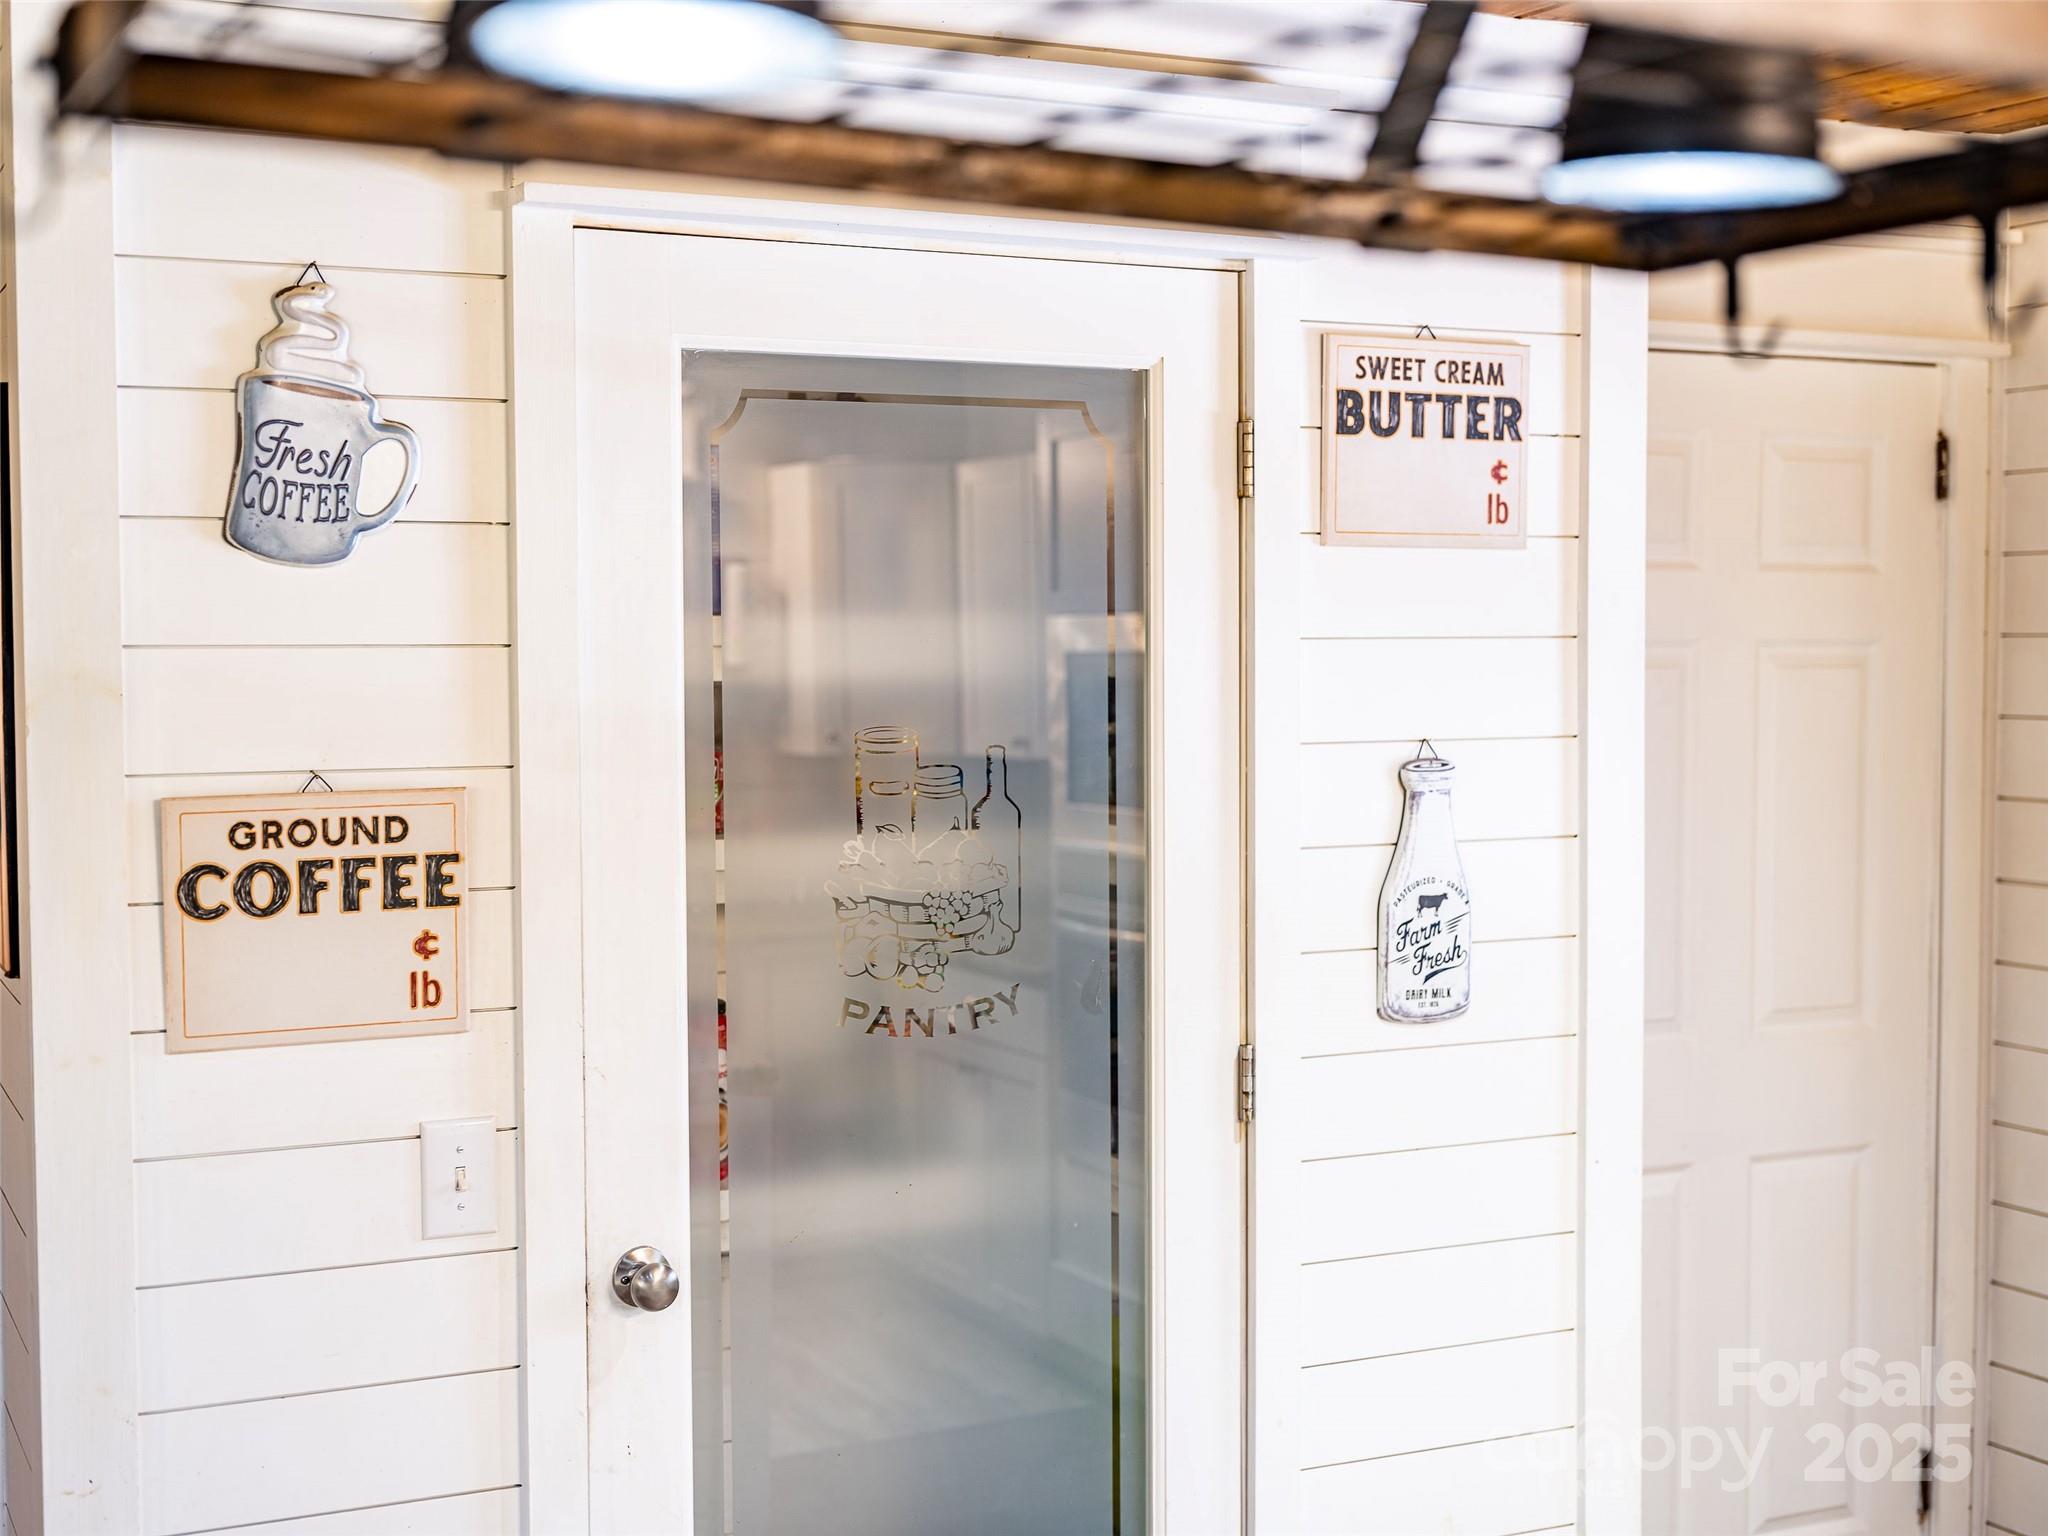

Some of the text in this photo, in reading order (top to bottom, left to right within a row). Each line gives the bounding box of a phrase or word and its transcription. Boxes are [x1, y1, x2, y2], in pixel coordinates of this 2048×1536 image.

[1355, 355, 1505, 386] SWEET CREAM
[1336, 388, 1523, 442] BUTTER
[255, 418, 352, 482] Fresh
[1490, 460, 1508, 484] ¢
[242, 469, 350, 523] COFFEE
[1487, 493, 1509, 525] lb
[228, 815, 409, 851] GROUND
[176, 853, 461, 921] COFFEE
[1393, 876, 1436, 908] PASTEURIZED
[413, 929, 439, 960] ¢
[1396, 917, 1443, 953] Farm
[1412, 934, 1463, 976] Fresh
[410, 971, 442, 1009] lb
[1405, 987, 1451, 1000] DAIRY MILK
[836, 982, 1021, 1038] PANTRY
